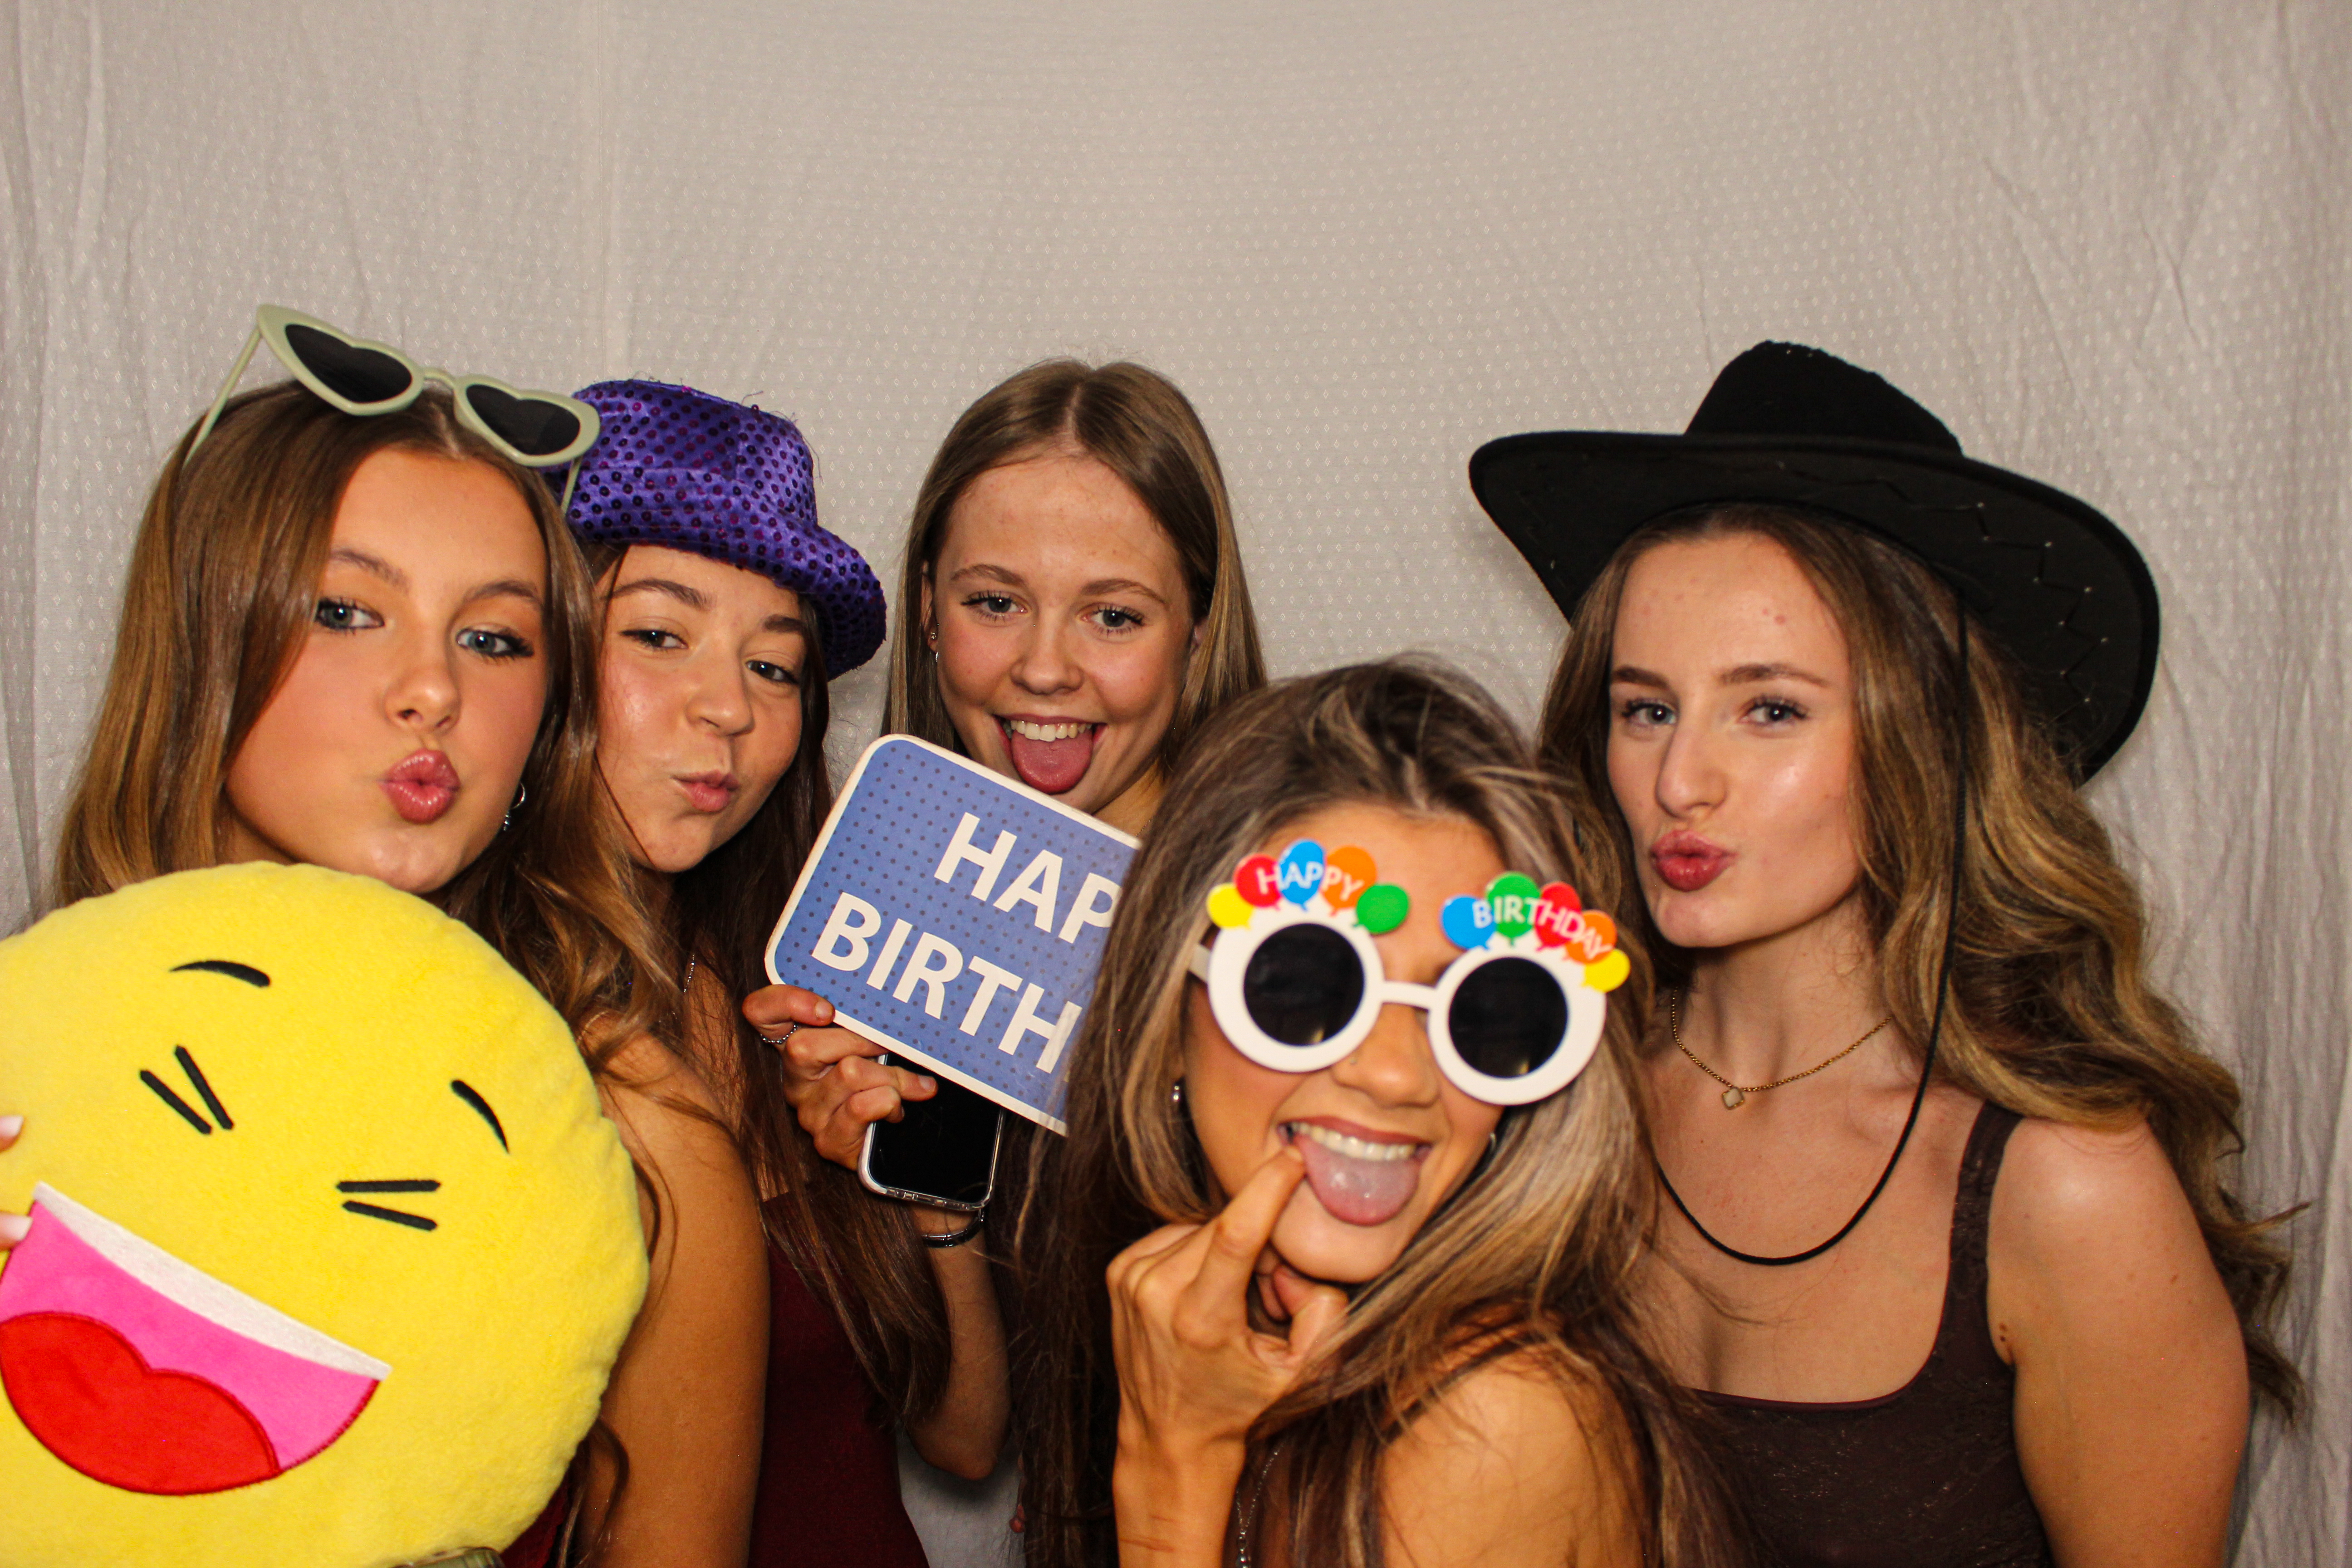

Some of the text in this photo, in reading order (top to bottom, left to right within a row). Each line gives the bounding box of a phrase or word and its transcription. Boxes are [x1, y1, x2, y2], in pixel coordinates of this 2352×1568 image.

[934, 812, 1122, 944] HAP
[1257, 862, 1611, 960] HAPPY BIRTHDAY
[811, 892, 1082, 1073] BIRTH
